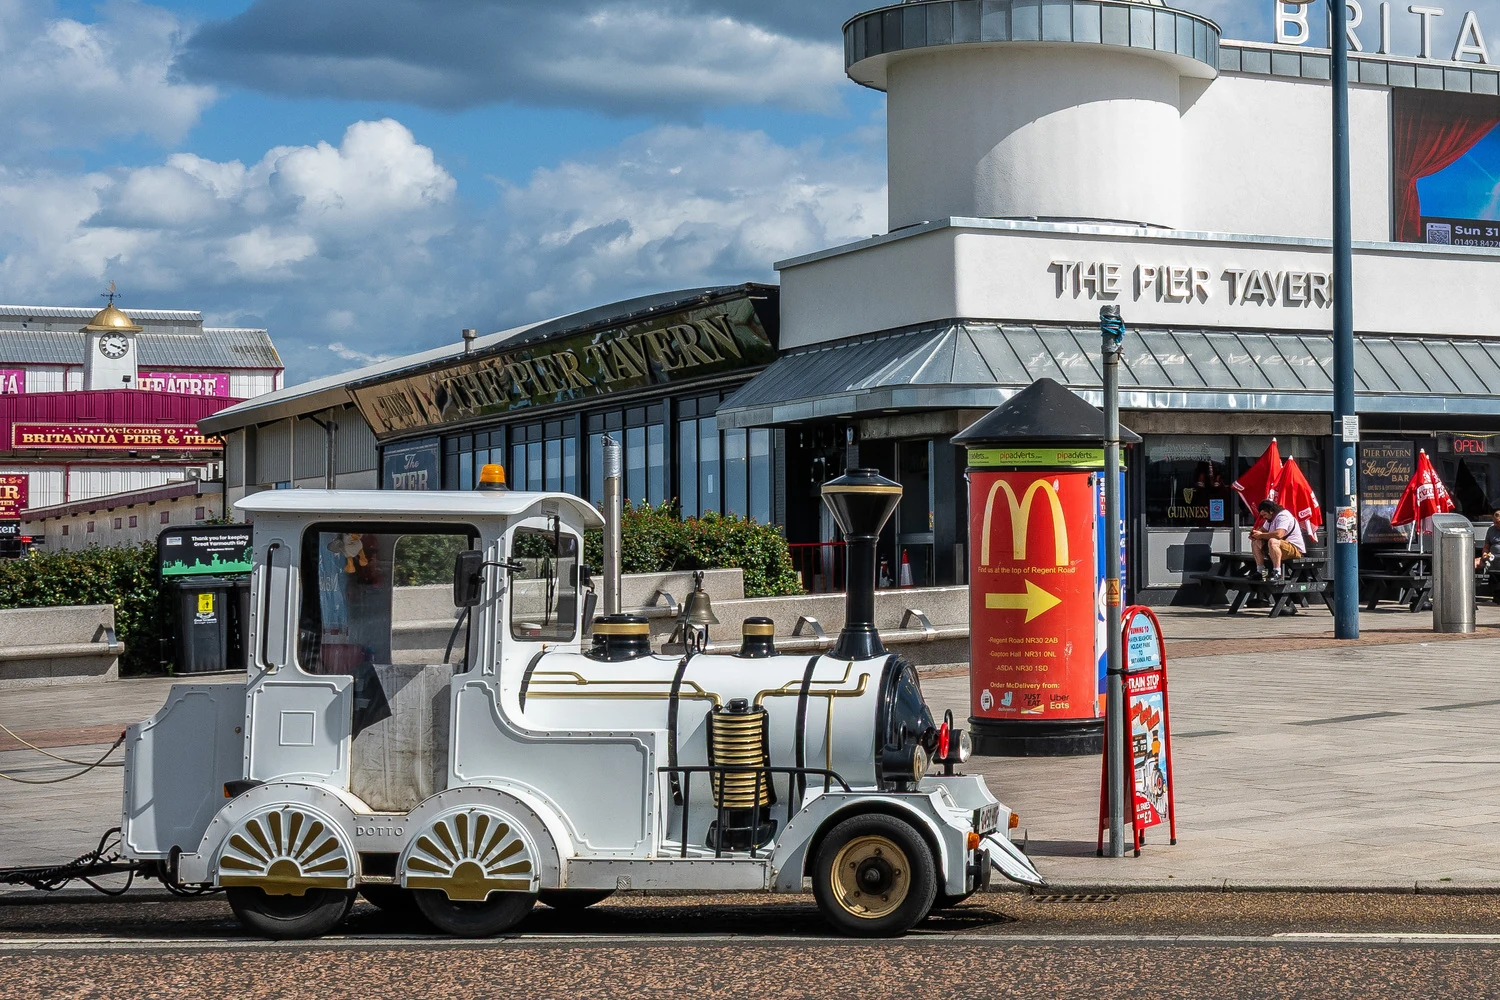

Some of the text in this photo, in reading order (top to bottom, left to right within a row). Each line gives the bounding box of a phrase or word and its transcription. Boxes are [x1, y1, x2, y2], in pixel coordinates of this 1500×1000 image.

[1455, 225, 1481, 236] Sun
[1485, 227, 1499, 237] 31
[1455, 239, 1479, 247] 01493
[1050, 260, 1333, 305] THE PIER TAVER
[441, 366, 510, 414] THE
[505, 350, 593, 399] PIER
[583, 313, 743, 383] TAVERN
[138, 378, 216, 396] HEATRE
[104, 427, 176, 435] Welcome to
[22, 433, 180, 445] BRITANNIA PIER &
[1453, 439, 1484, 453] OPEN
[1363, 449, 1411, 457] PIER TAVERN
[404, 453, 420, 470] The
[1363, 460, 1385, 477] Long
[391, 469, 429, 490] PIER
[1167, 506, 1209, 518] GUINNESS
[1006, 682, 1040, 690] McDelivery
[1128, 674, 1160, 689] TRAIN STOP
[1049, 693, 1069, 701] Uber
[1144, 811, 1152, 824] £2
[356, 825, 405, 837] DOTTO
